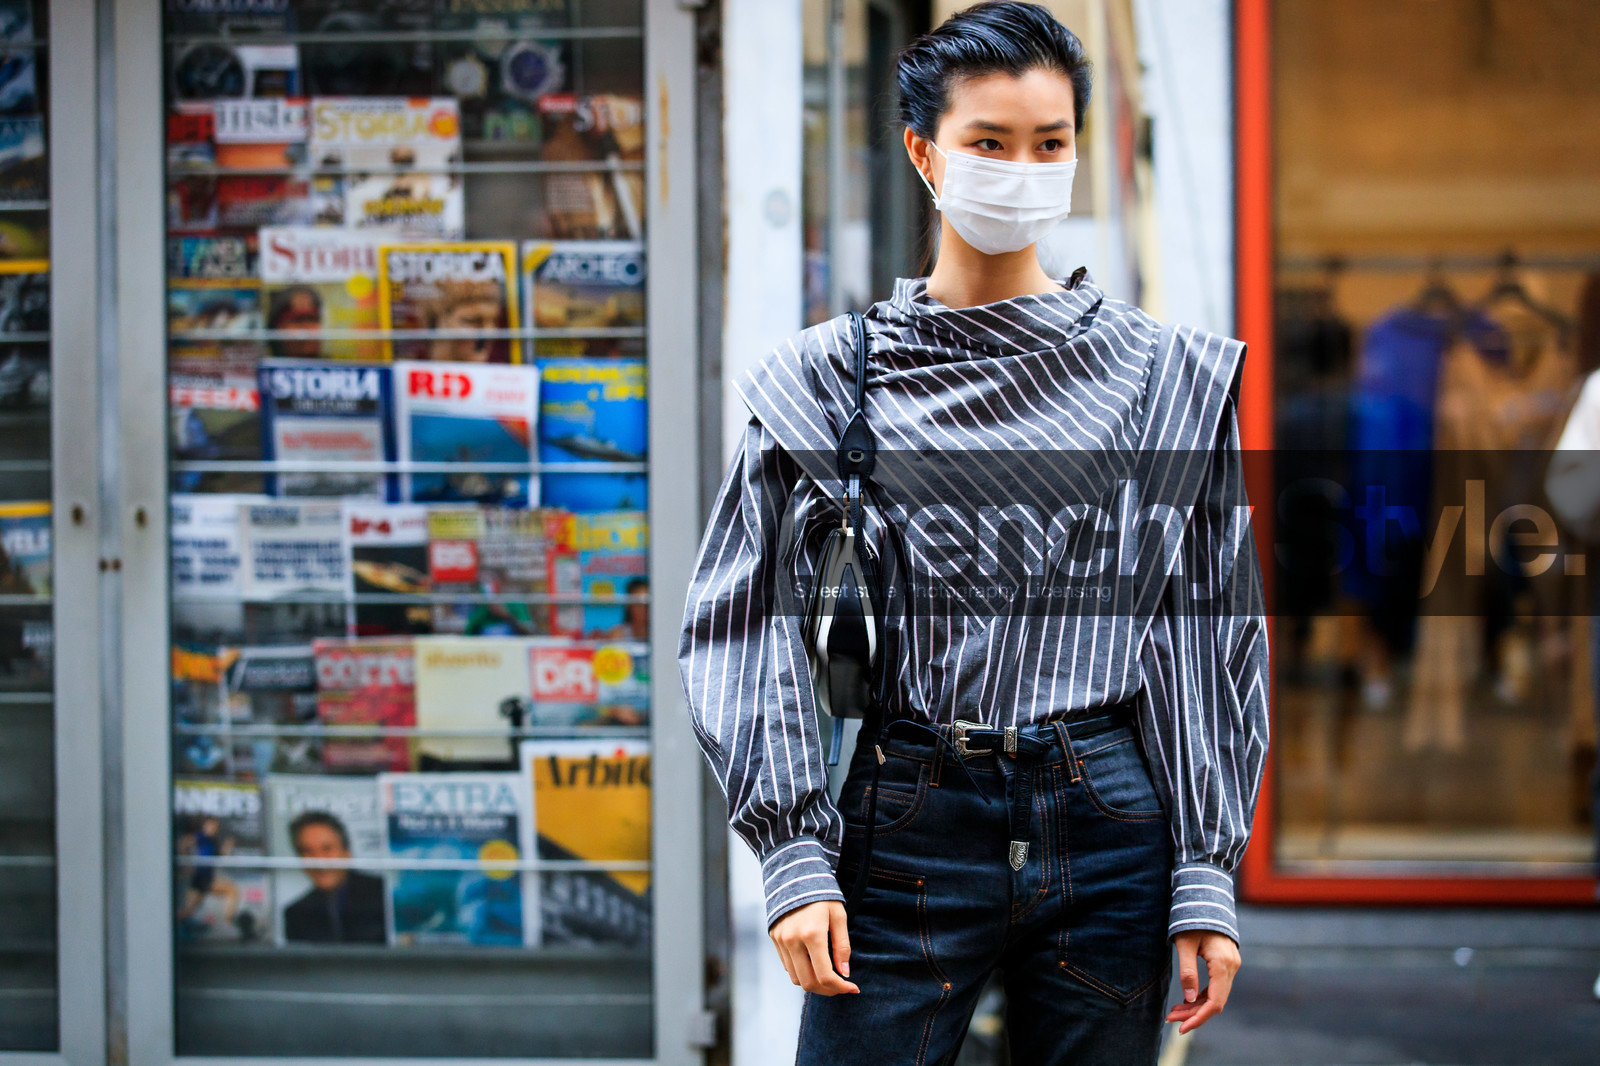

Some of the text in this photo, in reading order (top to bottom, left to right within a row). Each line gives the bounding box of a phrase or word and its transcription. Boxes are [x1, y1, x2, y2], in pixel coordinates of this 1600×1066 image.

[389, 253, 505, 281] STORICA
[272, 371, 380, 399] STORIA
[391, 780, 517, 813] EXTRA
